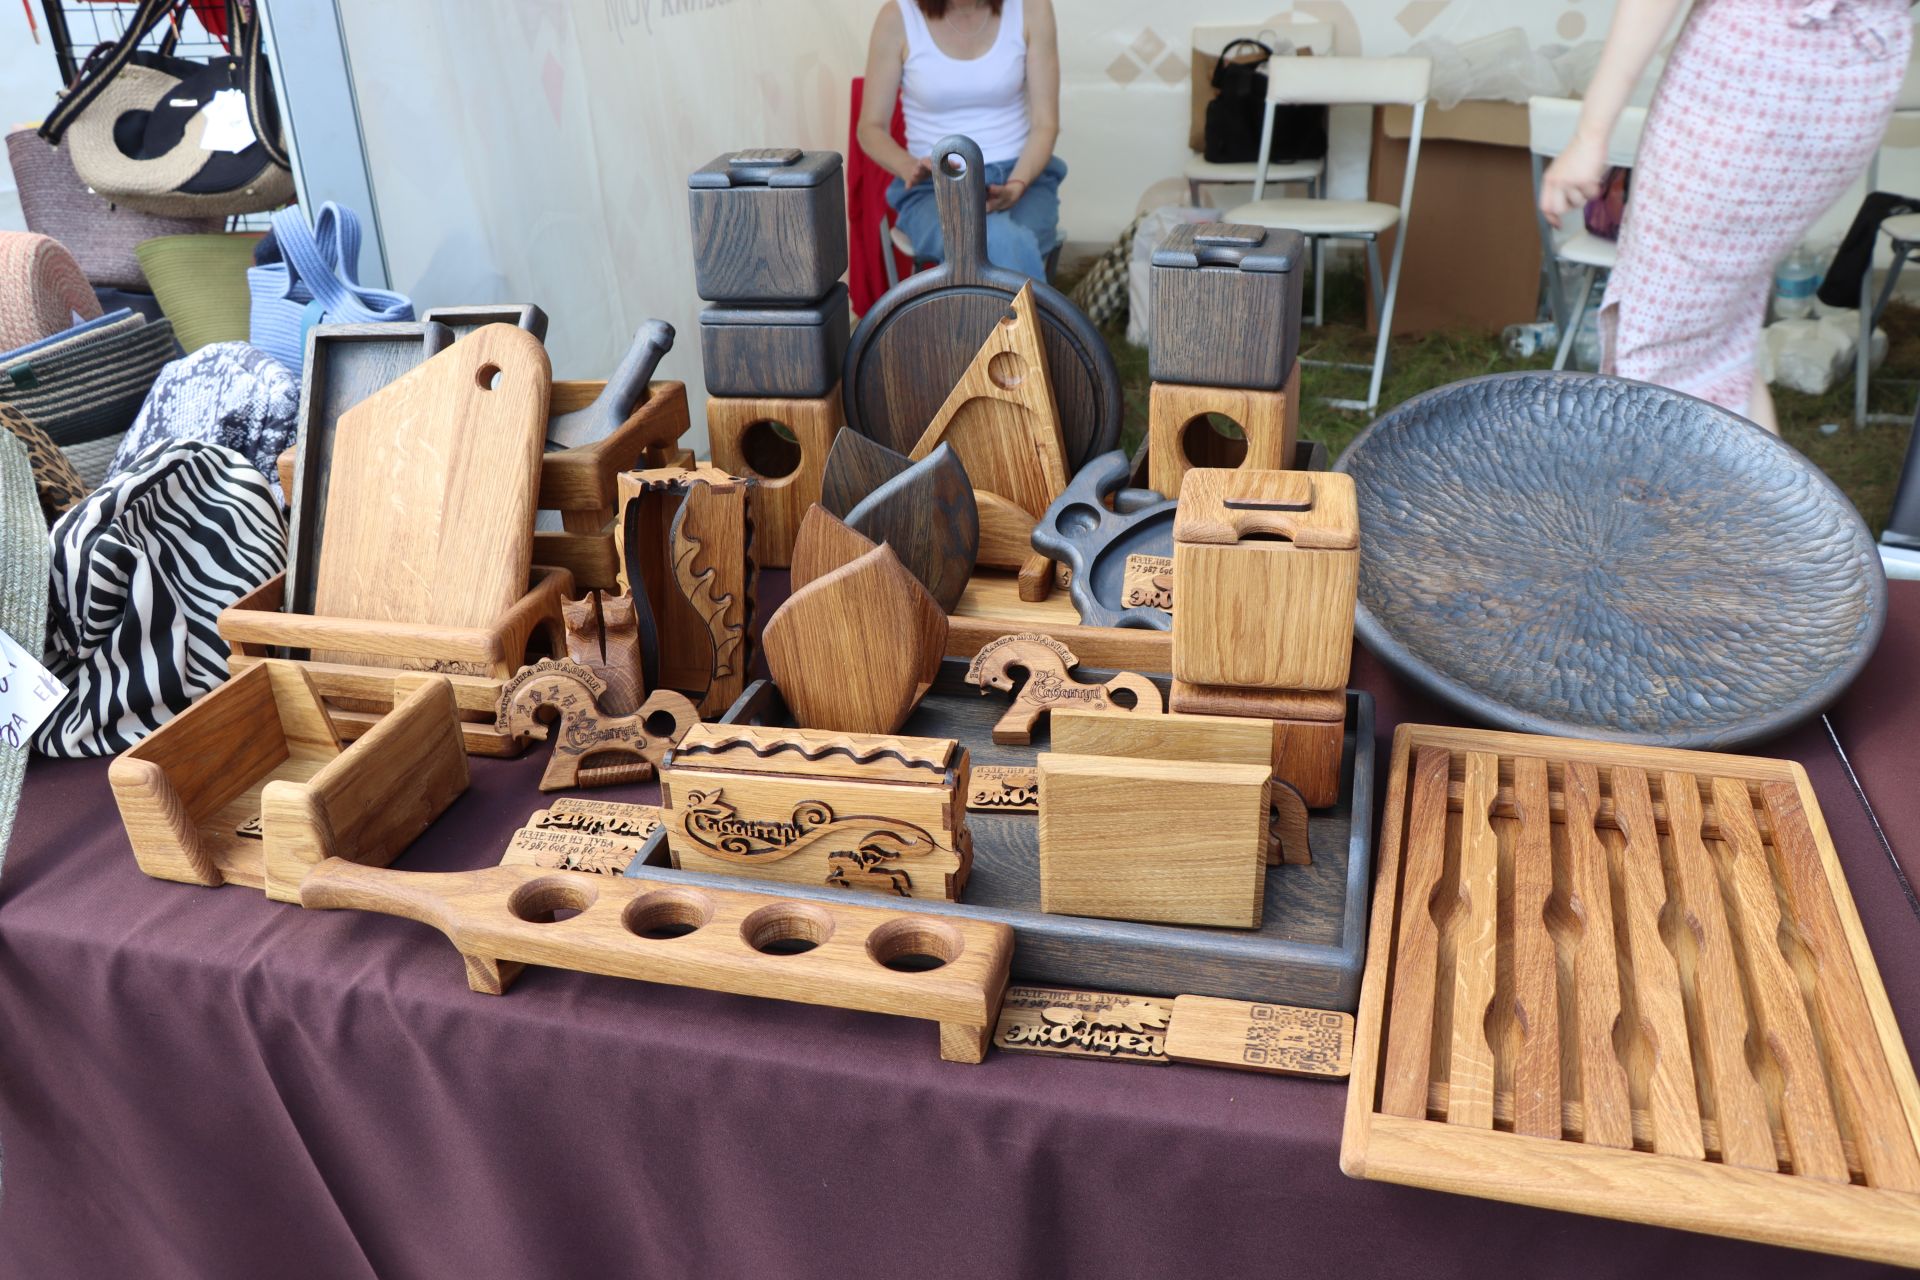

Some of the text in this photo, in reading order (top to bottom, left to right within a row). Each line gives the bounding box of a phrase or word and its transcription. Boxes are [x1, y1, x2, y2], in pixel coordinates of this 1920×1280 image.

[1128, 588, 1174, 610] ЭКО
[972, 789, 1039, 807] ЭКО
[516, 840, 529, 849] +7
[528, 841, 548, 851] 987
[518, 829, 614, 849] ИЗДЕЛИЯ ИЗ ДУБА
[1012, 987, 1072, 1001] ИЗДЕЛИЯ
[1075, 993, 1092, 1002] ИЗ
